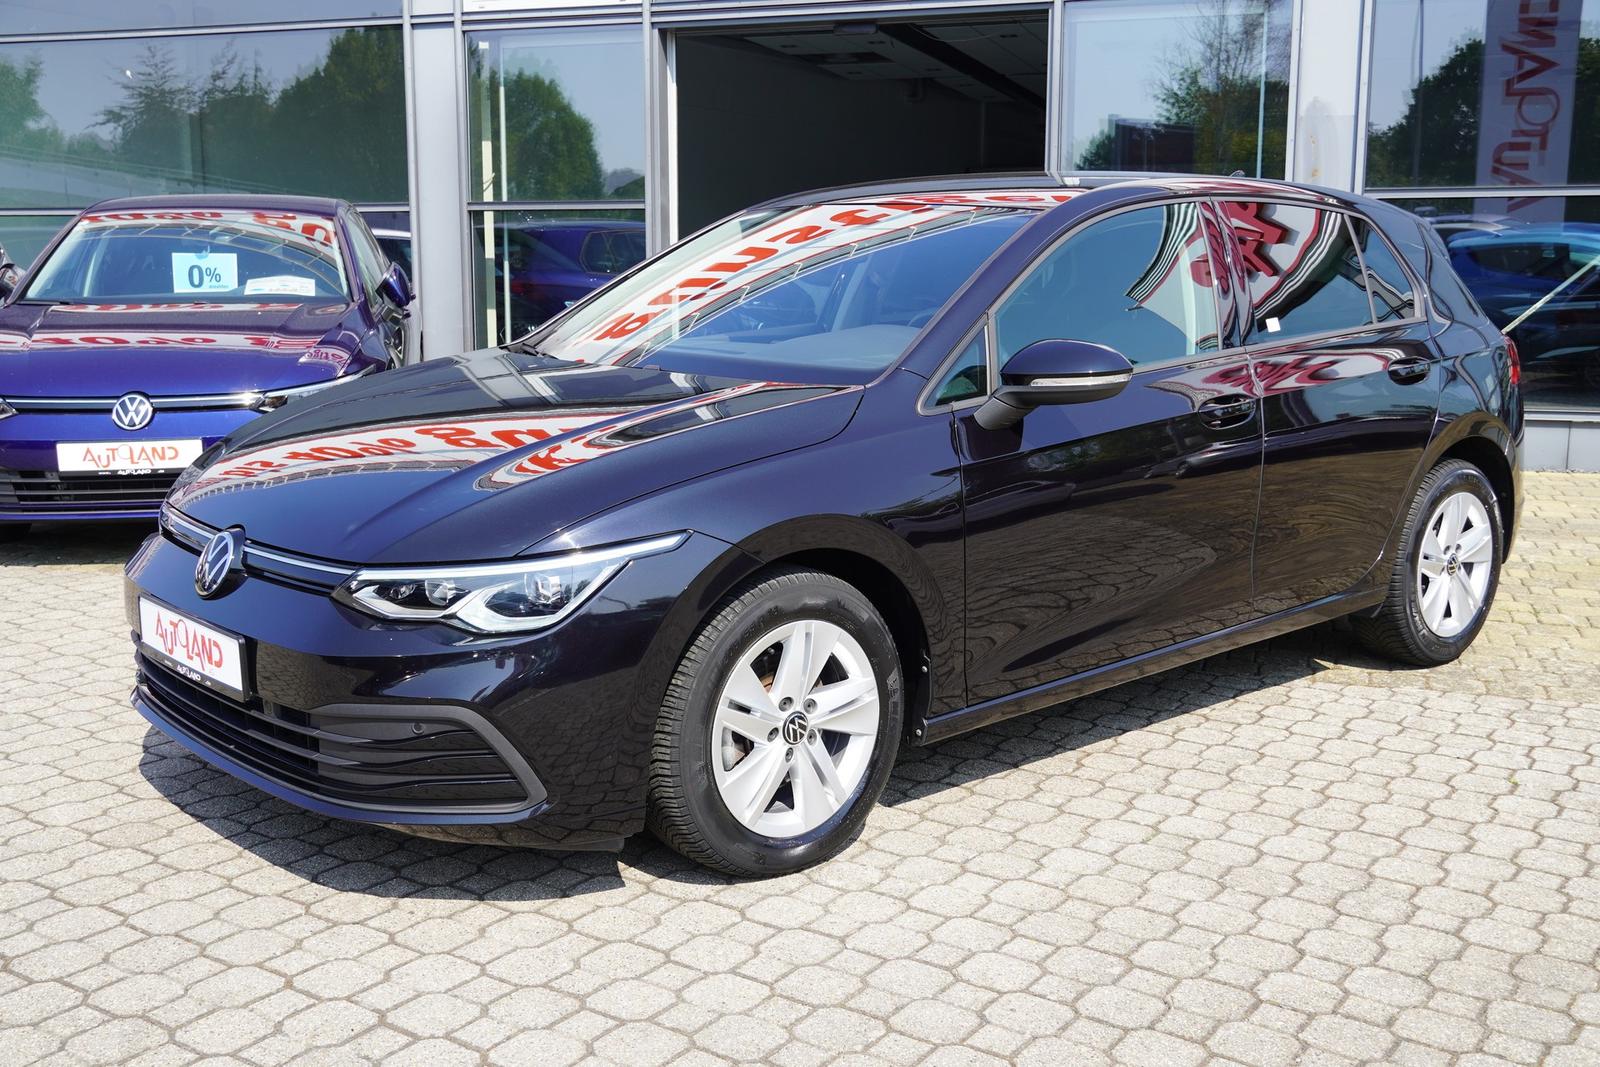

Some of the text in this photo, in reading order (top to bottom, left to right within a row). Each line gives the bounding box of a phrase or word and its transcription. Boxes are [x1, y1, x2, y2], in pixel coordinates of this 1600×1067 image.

[188, 264, 221, 289] 0%
[82, 444, 179, 468] AUTOLAND
[155, 610, 223, 672] AUTOLAND
